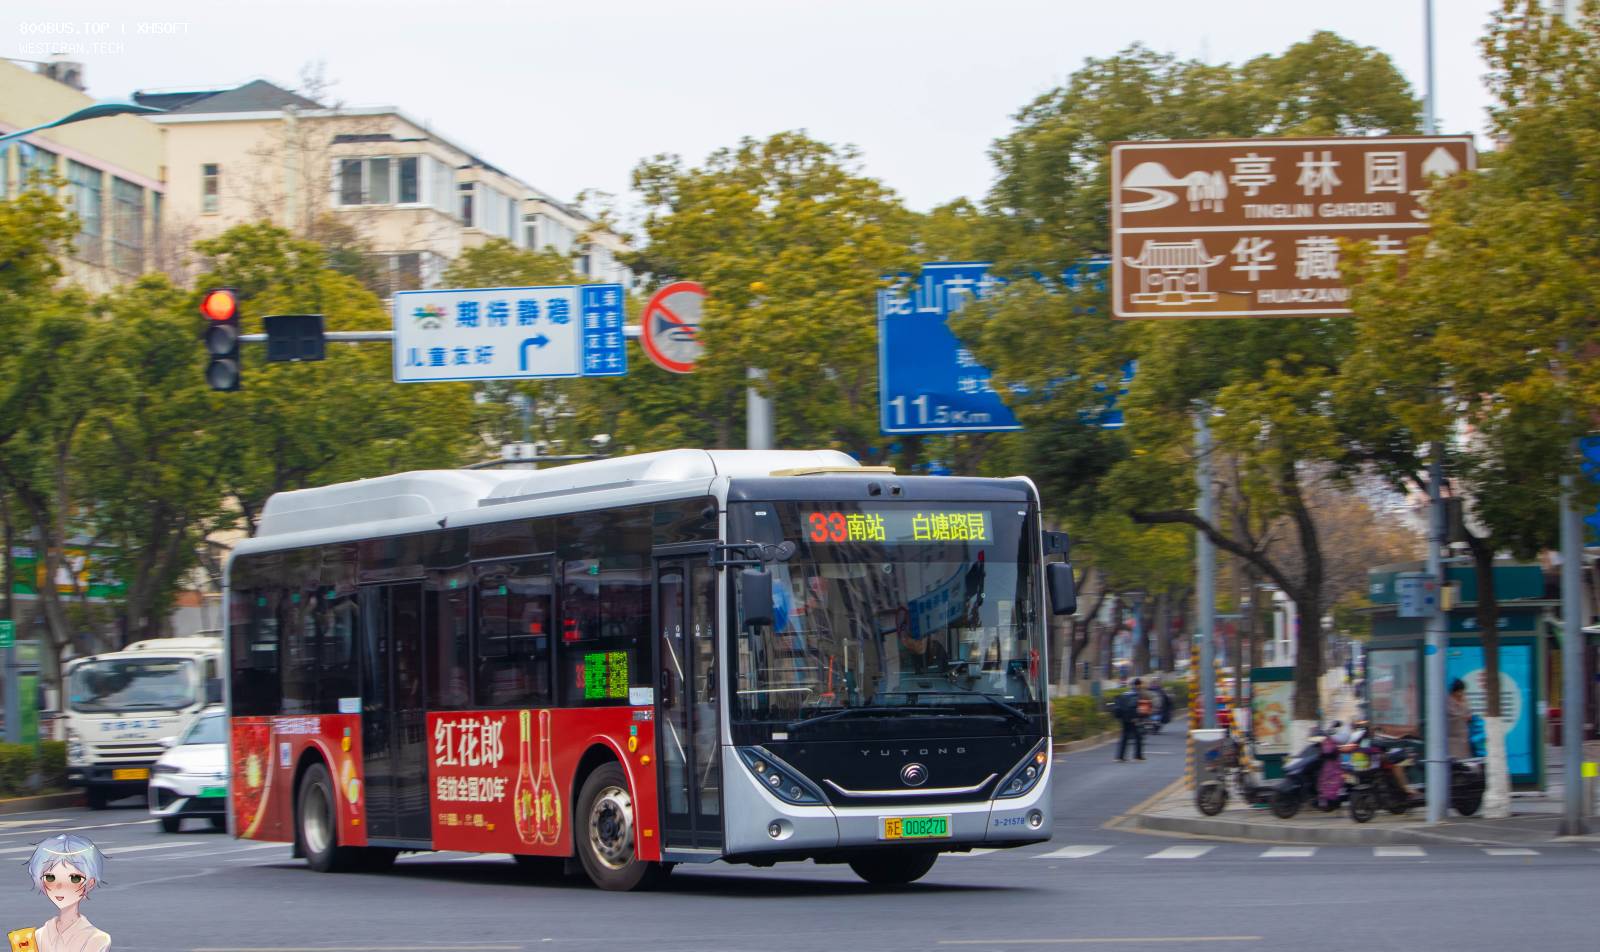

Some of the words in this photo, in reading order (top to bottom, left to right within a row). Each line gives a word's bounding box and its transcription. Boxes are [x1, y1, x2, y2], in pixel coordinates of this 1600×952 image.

[1229, 152, 1407, 197] 亭林园
[1242, 203, 1314, 219] TINGLIN
[1319, 202, 1397, 218] GARDEN
[1257, 288, 1352, 304] HUAZAN
[405, 345, 496, 367] 儿童友好
[809, 512, 848, 543] 33
[846, 513, 886, 542] 南站
[912, 512, 986, 541] 白塘路昆
[435, 716, 504, 769] 红花郎
[861, 747, 966, 756] YUTONG
